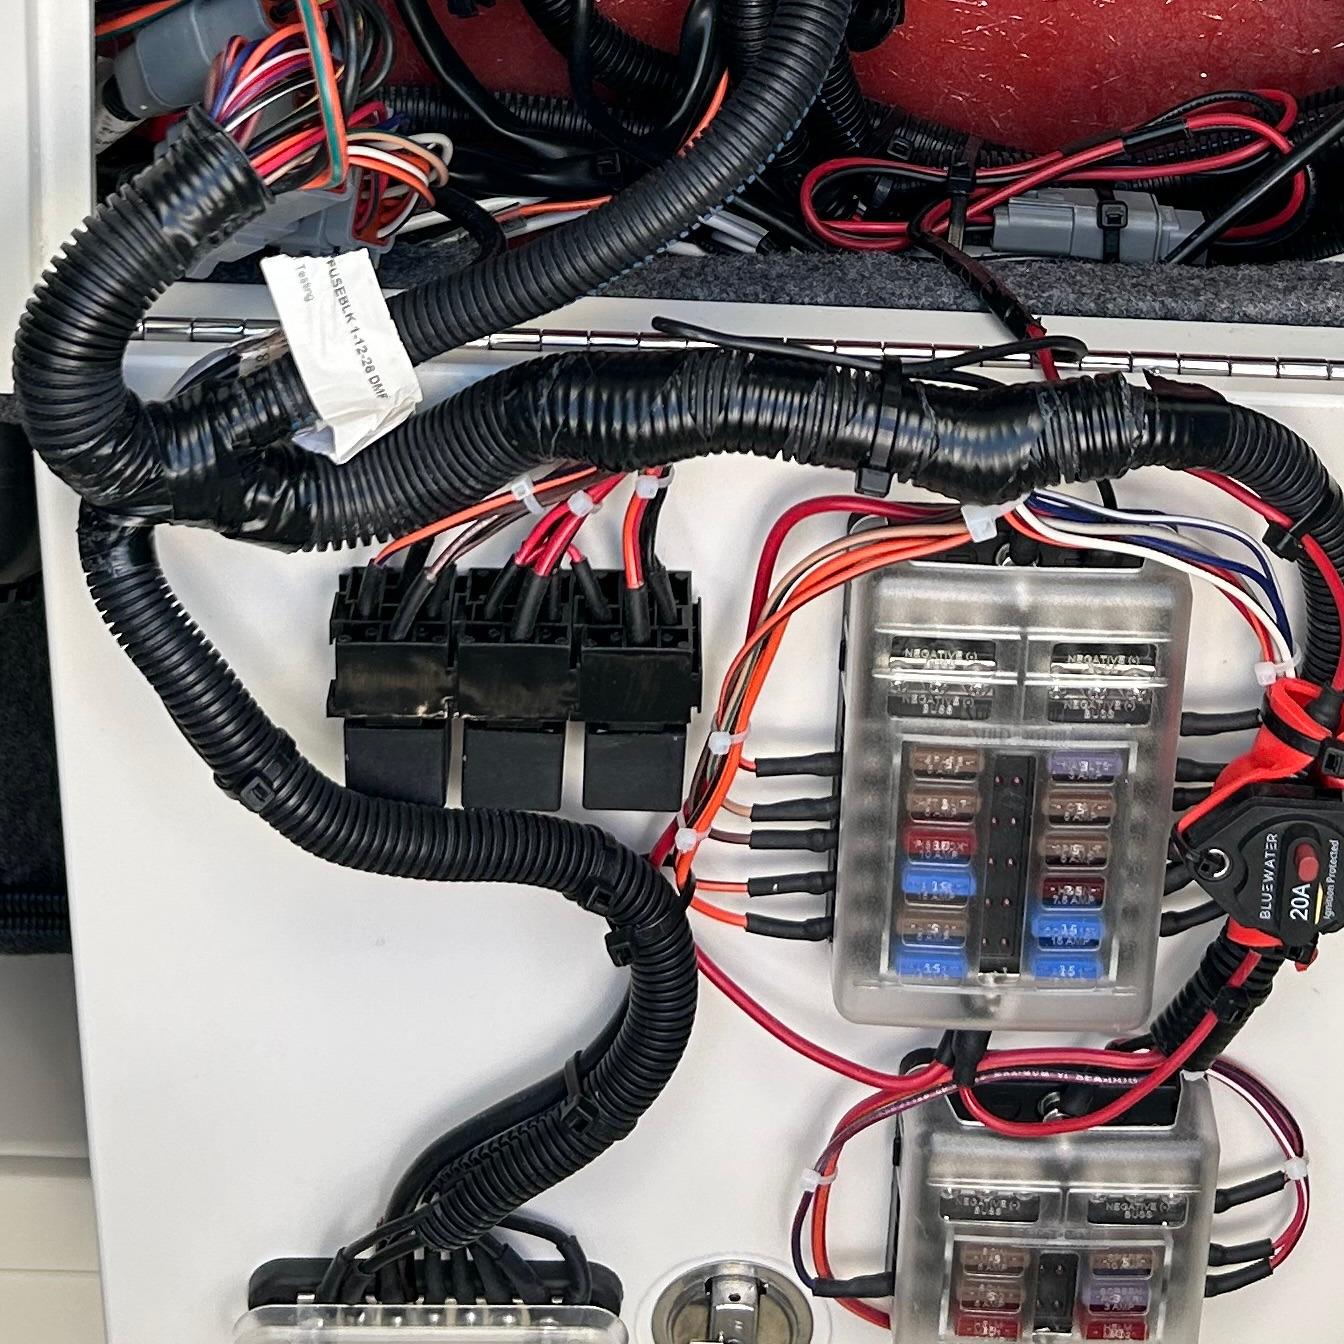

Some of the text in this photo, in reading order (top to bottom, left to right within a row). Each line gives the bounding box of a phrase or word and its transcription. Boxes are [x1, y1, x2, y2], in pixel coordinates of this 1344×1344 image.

[904, 647, 964, 661] NEGATIVE
[1067, 655, 1126, 665] NEGATIVE
[902, 695, 961, 707] NEGATIVE
[1063, 698, 1122, 711] NEGATIVE
[921, 704, 954, 715] BUSS
[1083, 709, 1116, 719] BUSS
[1325, 838, 1340, 884] Protected
[1259, 832, 1279, 921] BLUEWATER
[1070, 895, 1096, 905] AMP
[1289, 882, 1312, 922] 20A
[1065, 935, 1090, 946] AMP
[956, 1197, 1008, 1209] NEGATIVE
[1105, 1201, 1158, 1213] NEGATIVE
[973, 1205, 1002, 1217] BUSS
[1123, 1209, 1154, 1220] BUSS
